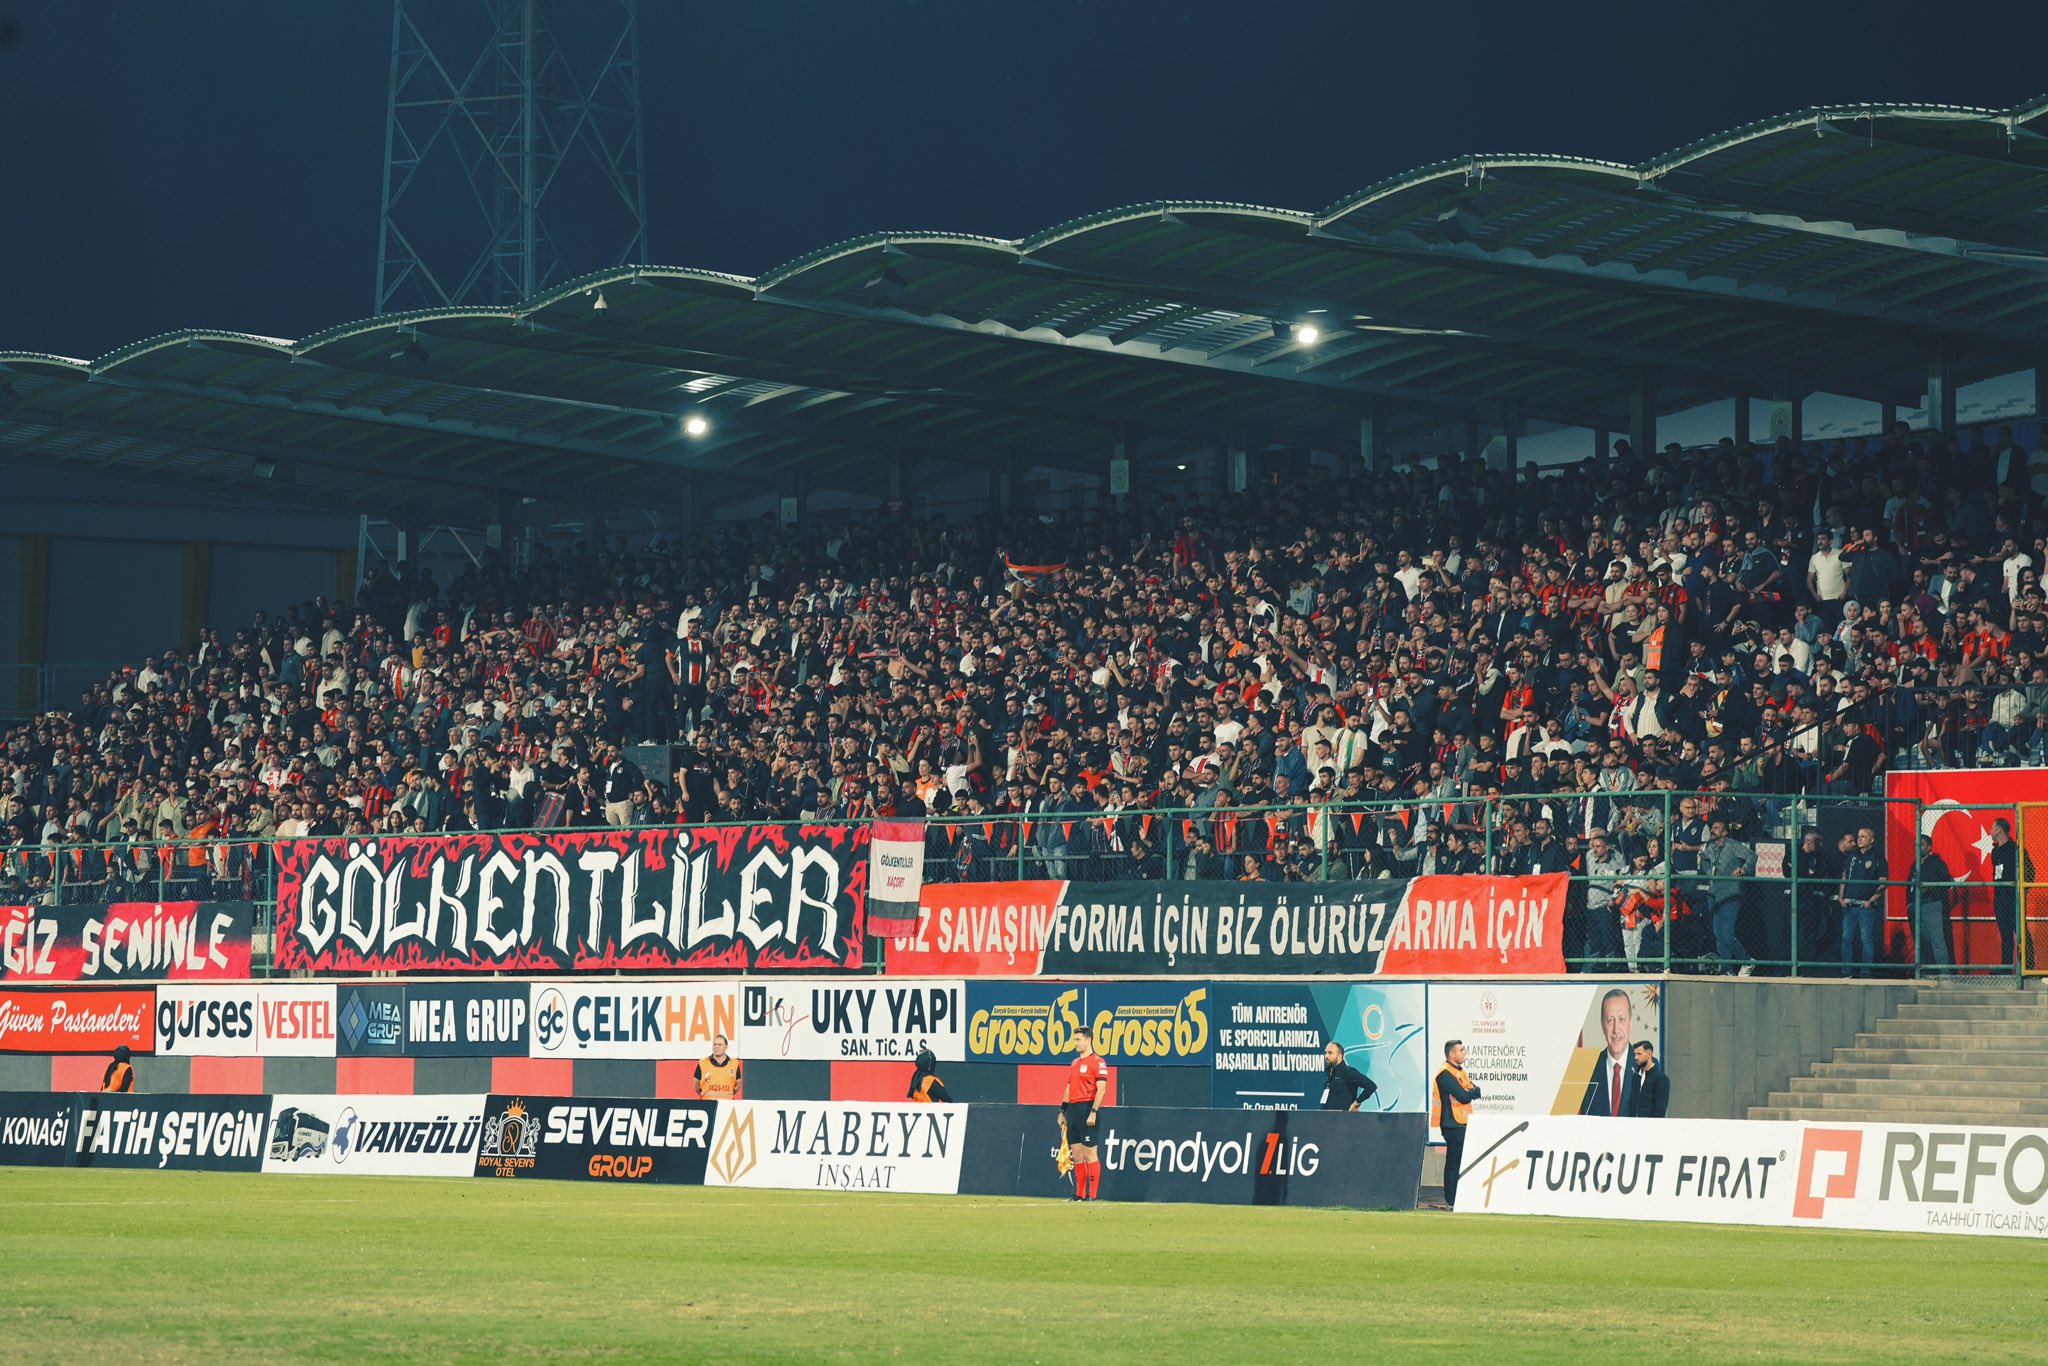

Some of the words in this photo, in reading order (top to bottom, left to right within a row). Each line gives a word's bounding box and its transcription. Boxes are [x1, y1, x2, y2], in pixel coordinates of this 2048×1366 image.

[298, 832, 840, 959] GÖLKENTLİLER
[0, 906, 58, 975] ĞİZ
[82, 904, 234, 976] SENİNLE
[937, 904, 1046, 966] SAVAŞIN
[1054, 904, 1145, 952] FORMA
[1154, 893, 1209, 967] İÇİN
[1216, 894, 1263, 955] BİZ
[1269, 894, 1386, 955] ÖLÜRÜZ
[1393, 899, 1477, 951] ARMA
[1487, 886, 1549, 964] İÇİN
[262, 1001, 334, 1039] VESTEL
[368, 1001, 401, 1022] MEA
[409, 1000, 457, 1042] MEA
[466, 998, 526, 1042] GRUP
[811, 989, 877, 1034] UKY
[885, 988, 957, 1034] YAPI
[1092, 988, 1208, 1056] Gross65
[1231, 1002, 1253, 1024] TÜM
[1255, 1002, 1308, 1024] ANTRENÖR
[367, 1022, 402, 1041] GRUP
[841, 1038, 872, 1056] SAN.
[1219, 1029, 1232, 1046] VE
[1234, 1029, 1320, 1048] SPORCULARIMIZA
[1215, 1052, 1270, 1072] BAŞARILAR
[1271, 1050, 1325, 1072] DİLİYORUM
[1472, 1044, 1514, 1057] ANTRENÖR
[1516, 1046, 1526, 1056] VE
[1489, 1071, 1528, 1082] DİLİYORUM
[354, 1115, 482, 1154] VANGÖLÜ
[544, 1105, 710, 1148] SEVENLER
[770, 1109, 954, 1159] MABEYN
[479, 1156, 503, 1167] ROYAL
[588, 1154, 653, 1178] GROUP
[1104, 1129, 1252, 1182] trendyol
[495, 1168, 516, 1177] OTEL
[816, 1158, 896, 1191] İNŞAAT
[1525, 1150, 1664, 1195] TURGUT
[1926, 1208, 1982, 1228] TAAHHÜT
[1985, 1209, 2021, 1230] TİCARİ
